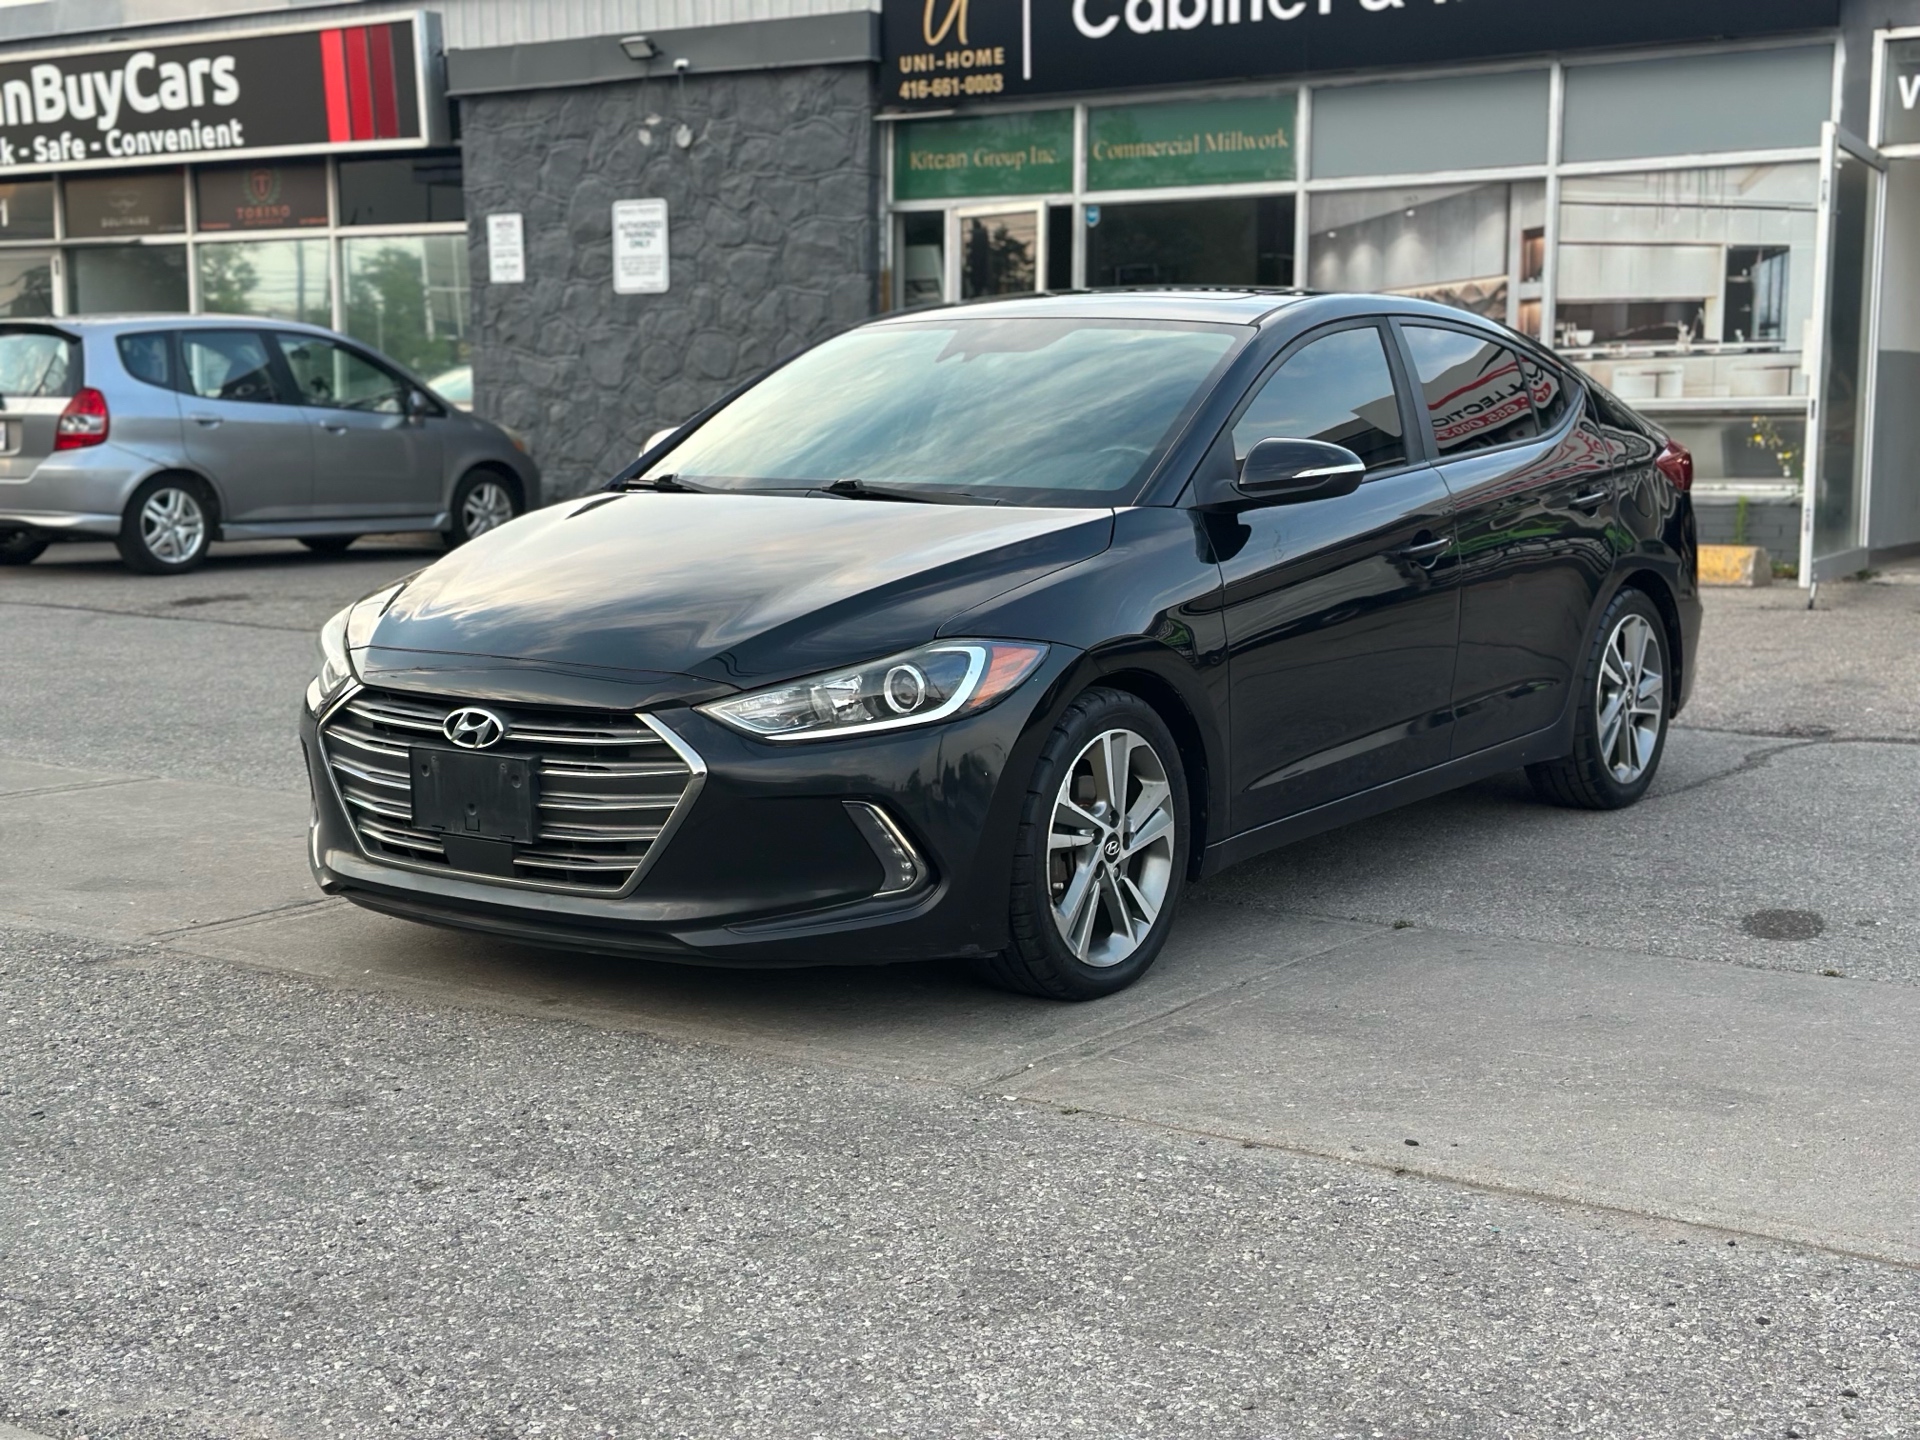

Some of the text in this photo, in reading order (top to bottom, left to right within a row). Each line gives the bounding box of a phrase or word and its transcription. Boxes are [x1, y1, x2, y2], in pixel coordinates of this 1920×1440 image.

[899, 46, 1005, 74] UNI-HOME
[0, 51, 240, 131] nBuyCars
[33, 131, 86, 162] Safe
[105, 118, 244, 157] Convenient
[1092, 127, 1289, 161] Commercial Millwork
[909, 151, 968, 170] Kitcan
[973, 147, 1026, 170] Group
